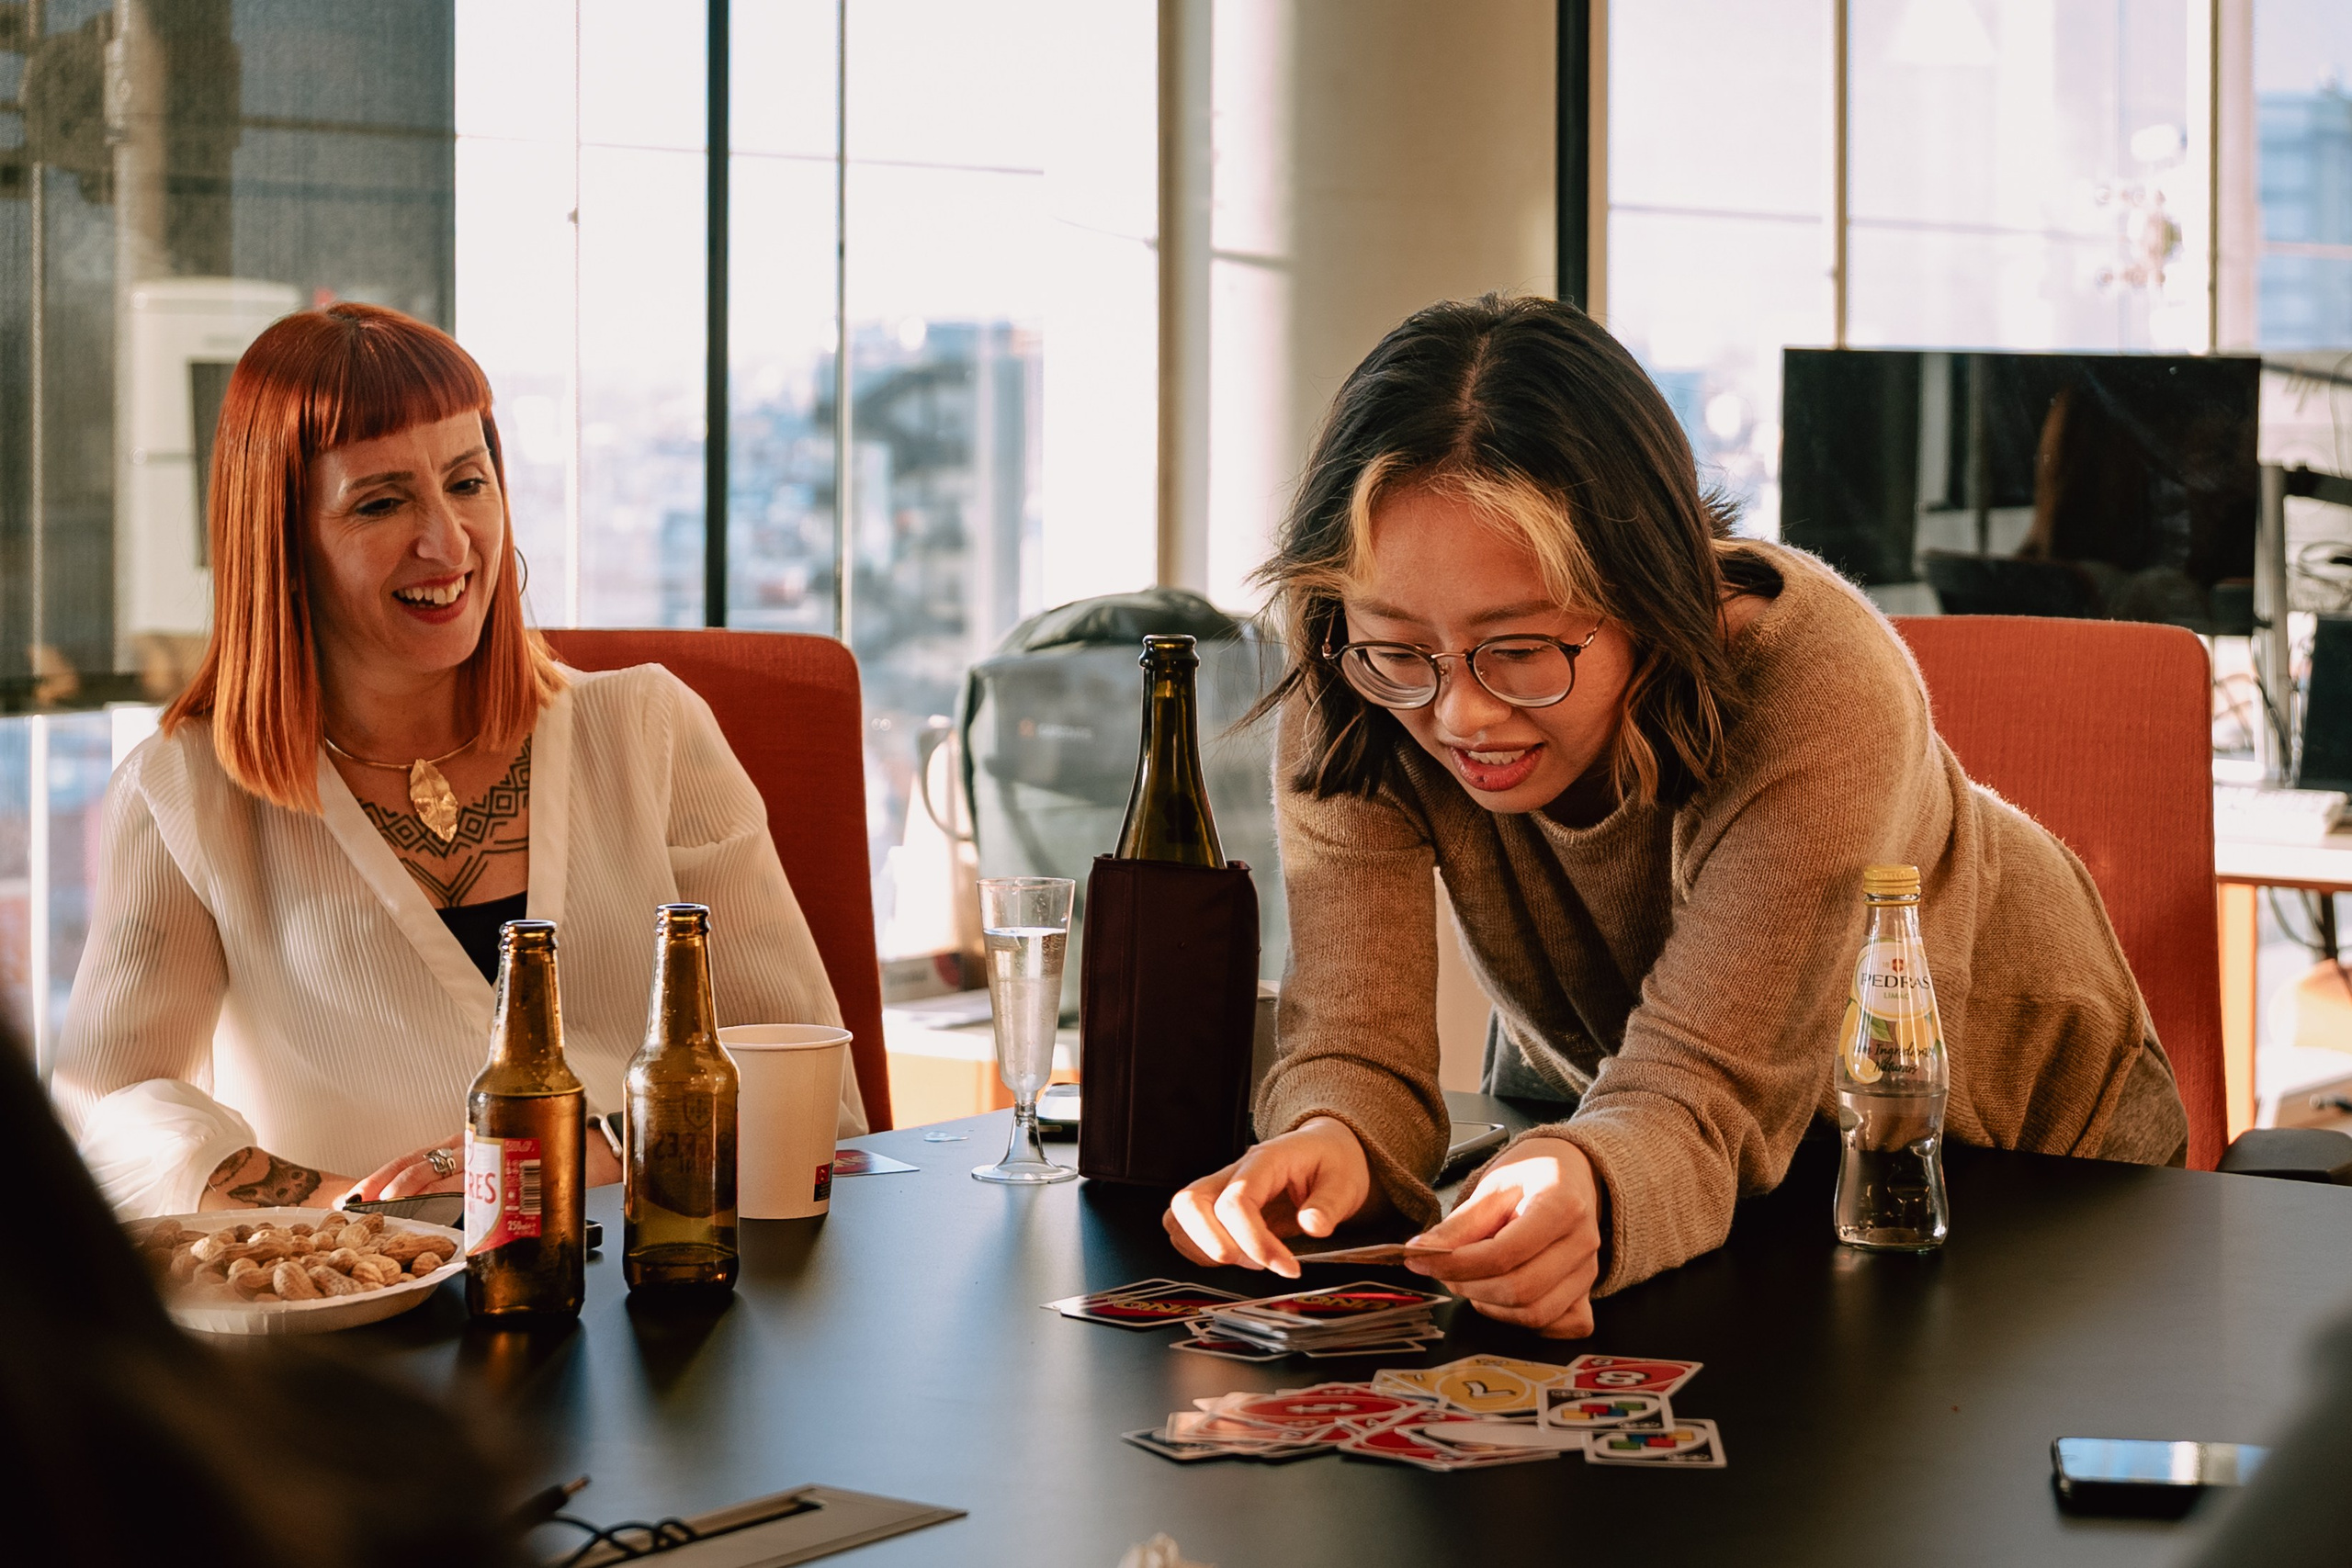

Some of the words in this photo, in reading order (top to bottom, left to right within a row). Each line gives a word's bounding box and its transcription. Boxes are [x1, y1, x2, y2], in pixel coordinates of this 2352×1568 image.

[1860, 973, 1930, 989] PEDRAS
[1114, 1301, 1200, 1315] UNO
[1595, 1371, 1647, 1386] 8
